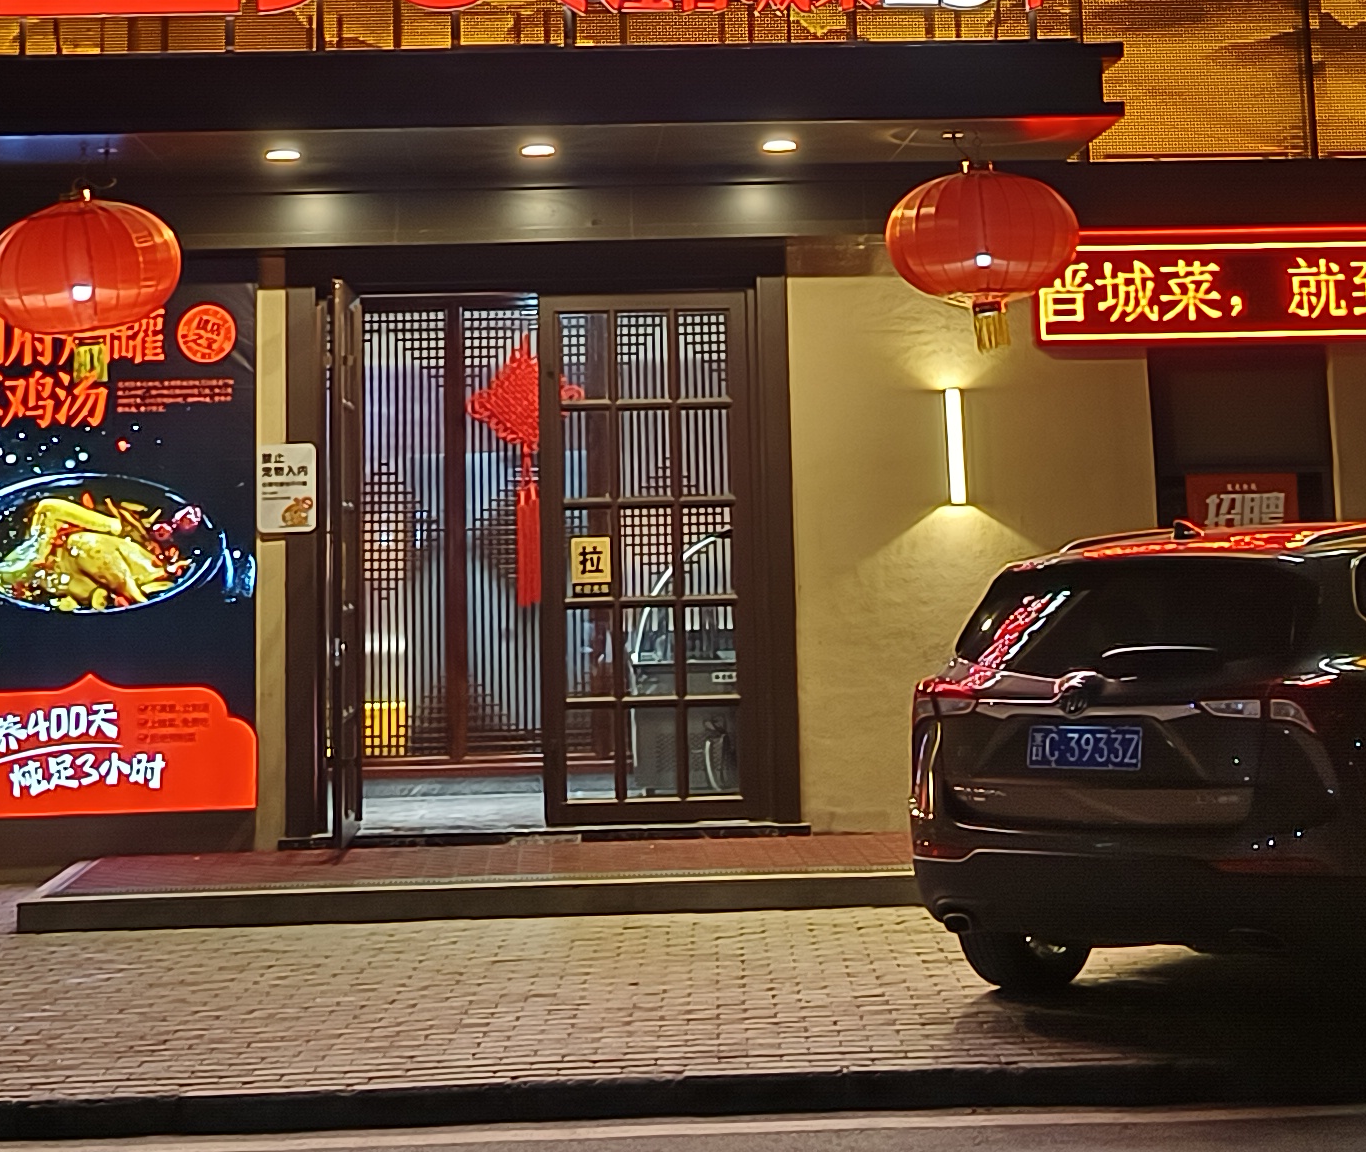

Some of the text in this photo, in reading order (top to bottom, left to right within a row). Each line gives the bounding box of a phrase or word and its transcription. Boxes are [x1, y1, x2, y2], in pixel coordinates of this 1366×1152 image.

[1204, 492, 1285, 527] 招聘
[578, 545, 604, 575] 拉
[9, 753, 166, 798] 炖足3小时
